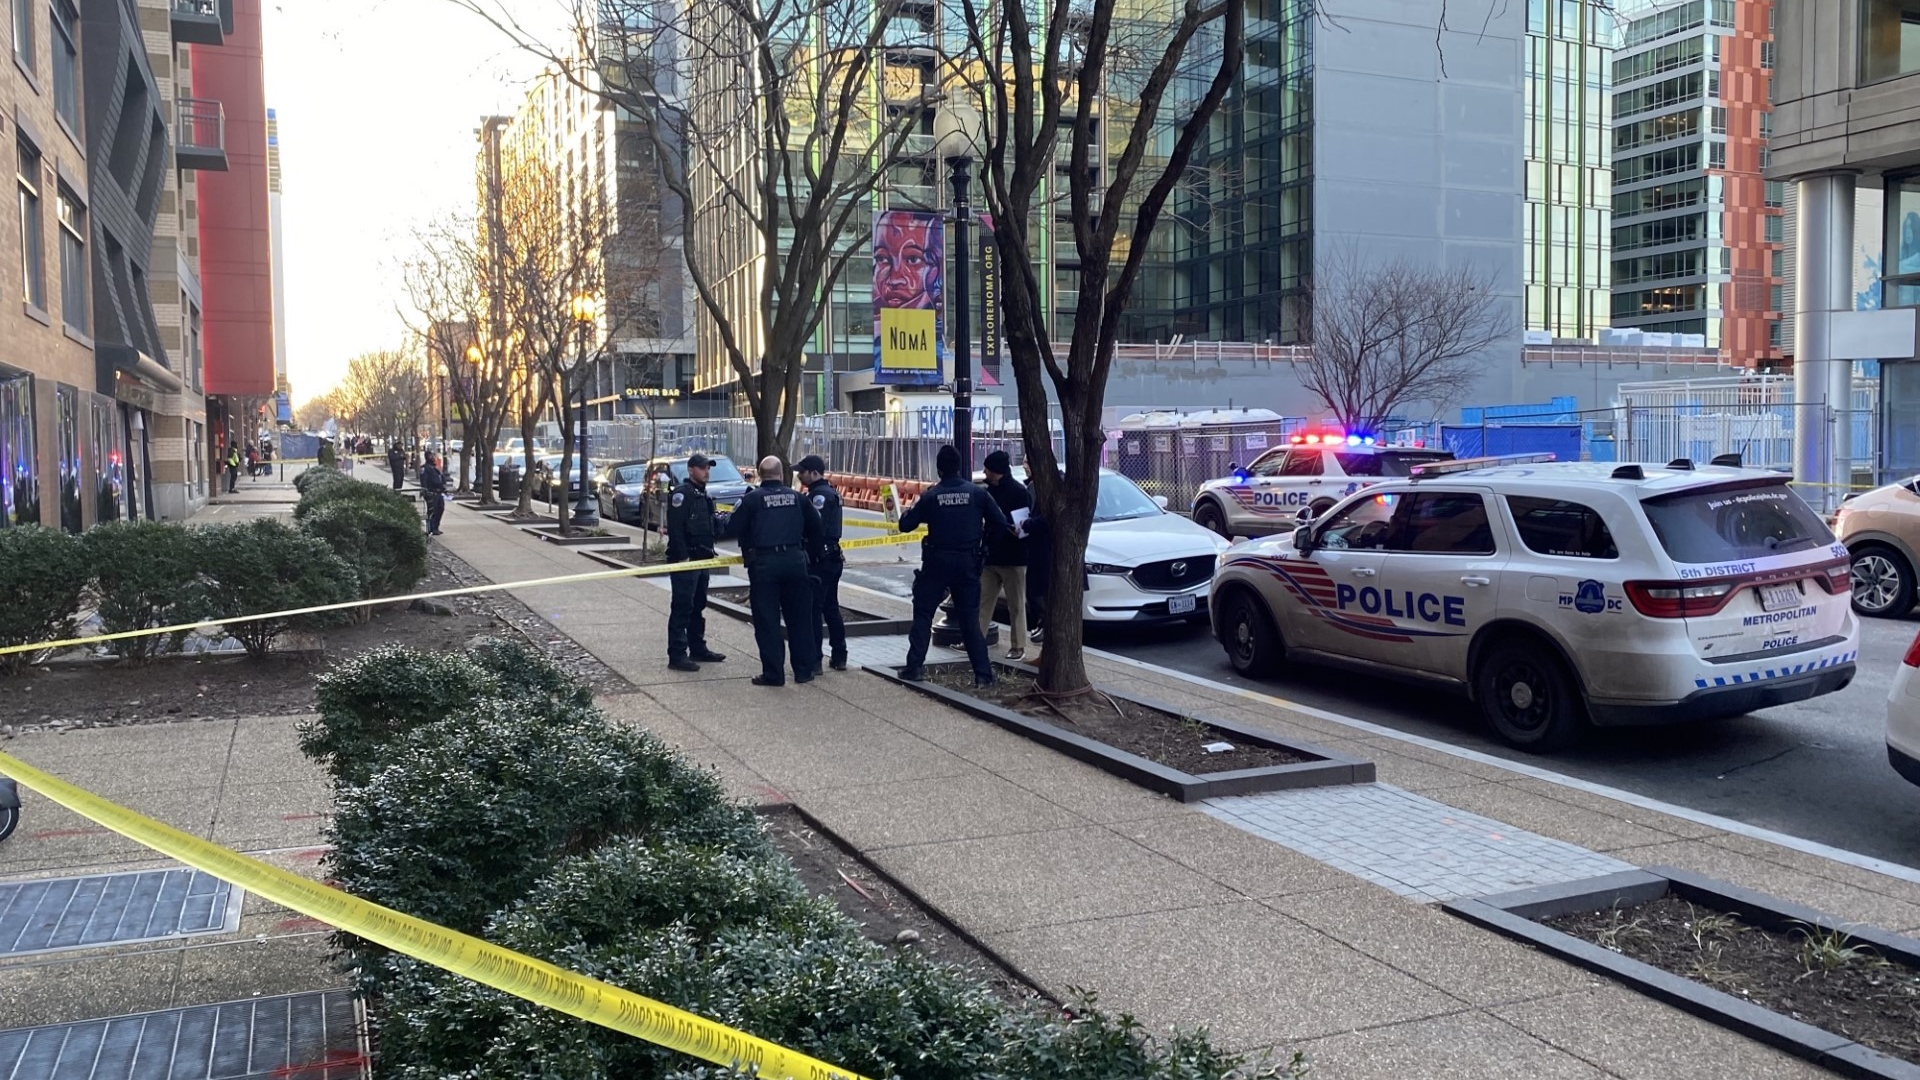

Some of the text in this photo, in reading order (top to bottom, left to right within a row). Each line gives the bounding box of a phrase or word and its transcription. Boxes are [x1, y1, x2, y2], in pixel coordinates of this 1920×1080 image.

[985, 245, 995, 356] EXPLORENOMA.ORG
[662, 388, 680, 397] BAR
[766, 499, 796, 508] POLICE
[939, 498, 969, 506] POLICE
[1254, 491, 1308, 506] POLICE
[1680, 567, 1701, 579] 5th
[1705, 562, 1756, 578] DISTRICT
[1337, 583, 1466, 627] POLICE
[1558, 595, 1622, 610] MP DC
[1743, 605, 1817, 627] METROPOLITAN
[1762, 636, 1798, 650] POLICE
